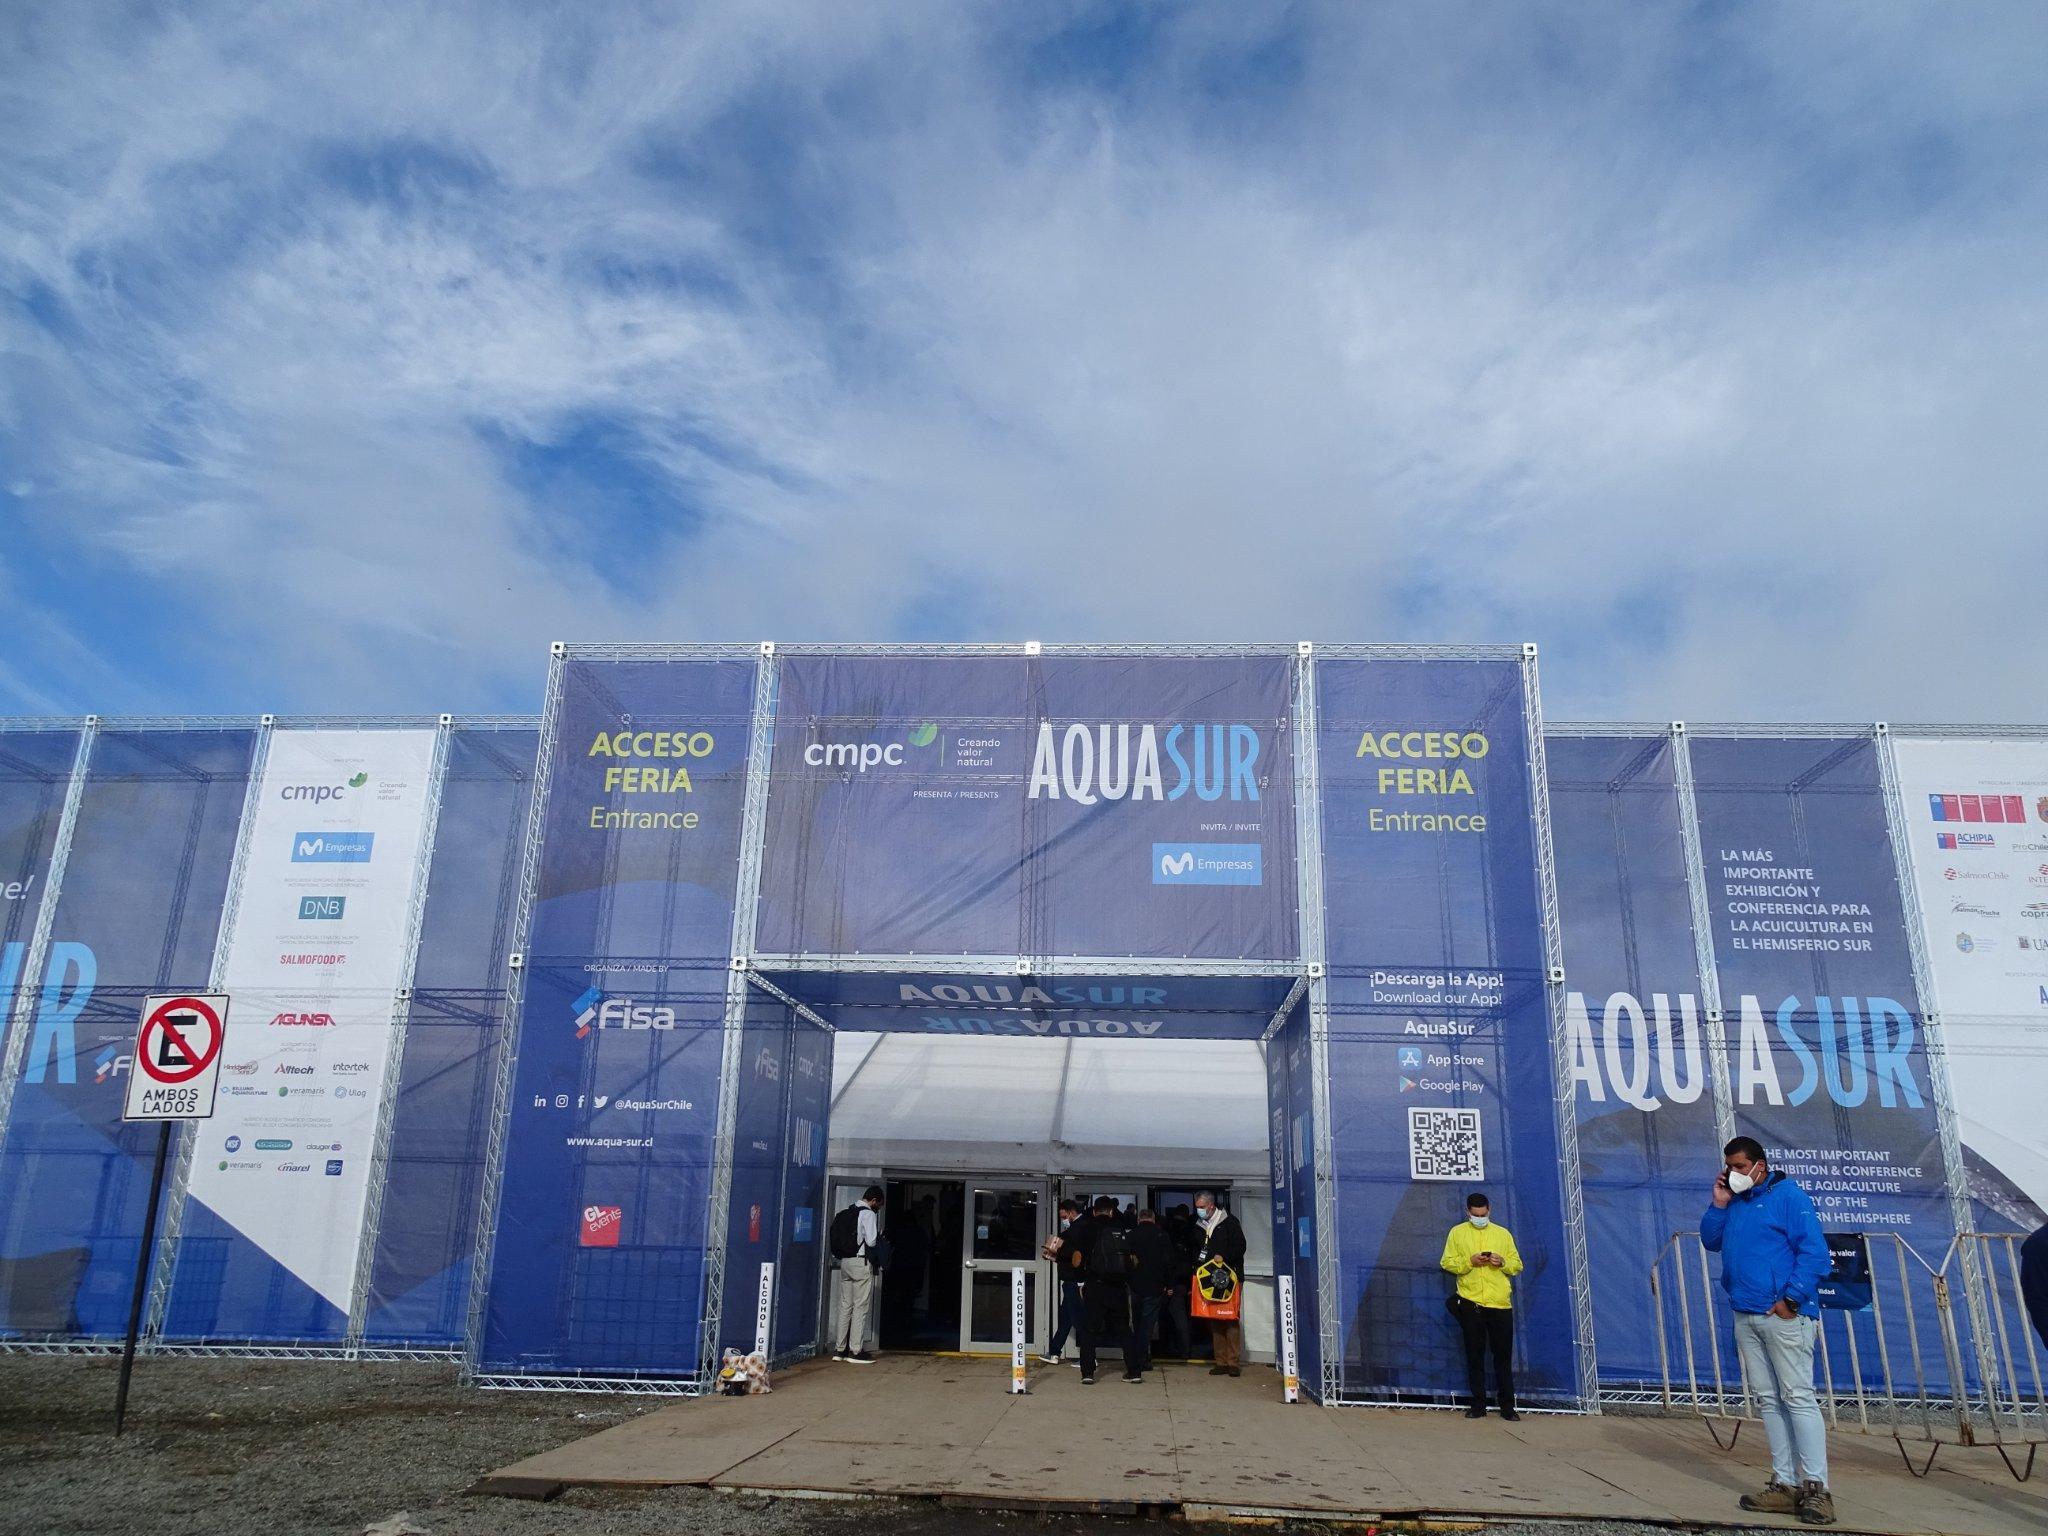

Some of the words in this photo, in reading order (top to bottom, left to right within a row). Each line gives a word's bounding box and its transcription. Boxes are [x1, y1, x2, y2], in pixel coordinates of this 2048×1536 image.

[588, 731, 714, 757] ACCESO
[958, 738, 1001, 747] Creando
[1355, 732, 1489, 759] ACCESO
[804, 743, 904, 772] cmpc
[957, 748, 983, 757] valor
[957, 757, 993, 766] natural
[1028, 723, 1260, 805] AQUASUR
[604, 767, 692, 793] FERIA
[1378, 768, 1474, 795] FERIA
[281, 785, 345, 804] cmpc
[913, 790, 952, 798] PRESENTA
[960, 791, 999, 799] PRESENTS
[590, 806, 699, 829] Entrance
[1369, 808, 1487, 832] Entrance
[1200, 823, 1227, 831] INVITA
[1235, 823, 1261, 832] INVITE
[1957, 833, 1994, 842] ACHIPIA
[325, 843, 366, 853] Empresas
[1721, 850, 1739, 861] LA
[1742, 848, 1773, 862] MÁS
[1198, 859, 1253, 871] Empresas
[1723, 867, 1814, 880] IMPORTANTE
[1726, 884, 1807, 898] EXHIBICIÓN
[1811, 886, 1821, 898] Y
[304, 898, 340, 917] DNB
[1728, 902, 1828, 915] CONFERENCIA
[1831, 904, 1871, 916] PARA
[1730, 920, 1749, 932] LA
[1752, 920, 1850, 933] ACUICULTURA
[1853, 922, 1873, 933] EN
[1733, 938, 1749, 950] EL
[1752, 938, 1840, 951] HEMISFERIO
[1843, 940, 1873, 952] SUR
[280, 955, 336, 965] SALMOFOOD
[584, 964, 625, 972] ORGANIZA
[659, 965, 669, 973] BY
[1369, 972, 1445, 988] ¡Descarga
[1448, 973, 1462, 986] la
[1465, 973, 1504, 989] App!
[900, 984, 1168, 1005] AQUASUR
[1373, 990, 1441, 1003] Download
[1444, 994, 1467, 1004] our
[1470, 992, 1502, 1007] App!
[1404, 1020, 1475, 1038] AquaSur
[1566, 991, 1925, 1112] AQUASUR
[332, 1062, 370, 1072] intertek
[1427, 1054, 1451, 1066] App
[1453, 1054, 1484, 1065] Store
[1419, 1079, 1460, 1093] Google
[1462, 1081, 1484, 1094] Play
[143, 1089, 198, 1101] AMBOS
[142, 1101, 195, 1113] LADOS
[615, 1099, 693, 1111] @AquaSurChile
[567, 1137, 654, 1149] www.aqua-sur.cl
[1784, 1149, 1817, 1160] MOST
[1820, 1150, 1891, 1162] IMPORTANT
[1767, 1164, 1828, 1176] XHIBITION
[1830, 1166, 1841, 1176] &
[1843, 1166, 1923, 1178] CONFERENCE
[1815, 1180, 1901, 1193] AQUACULTURE
[1824, 1196, 1842, 1208] OF
[1844, 1197, 1868, 1208] THE
[584, 1205, 607, 1222] GL
[589, 1208, 622, 1232] events
[1834, 1212, 1912, 1225] HEMISPHERE
[1837, 1249, 1857, 1257] valor
[760, 1274, 769, 1328] ALCOHOL
[1284, 1288, 1293, 1343] ALCOHOL
